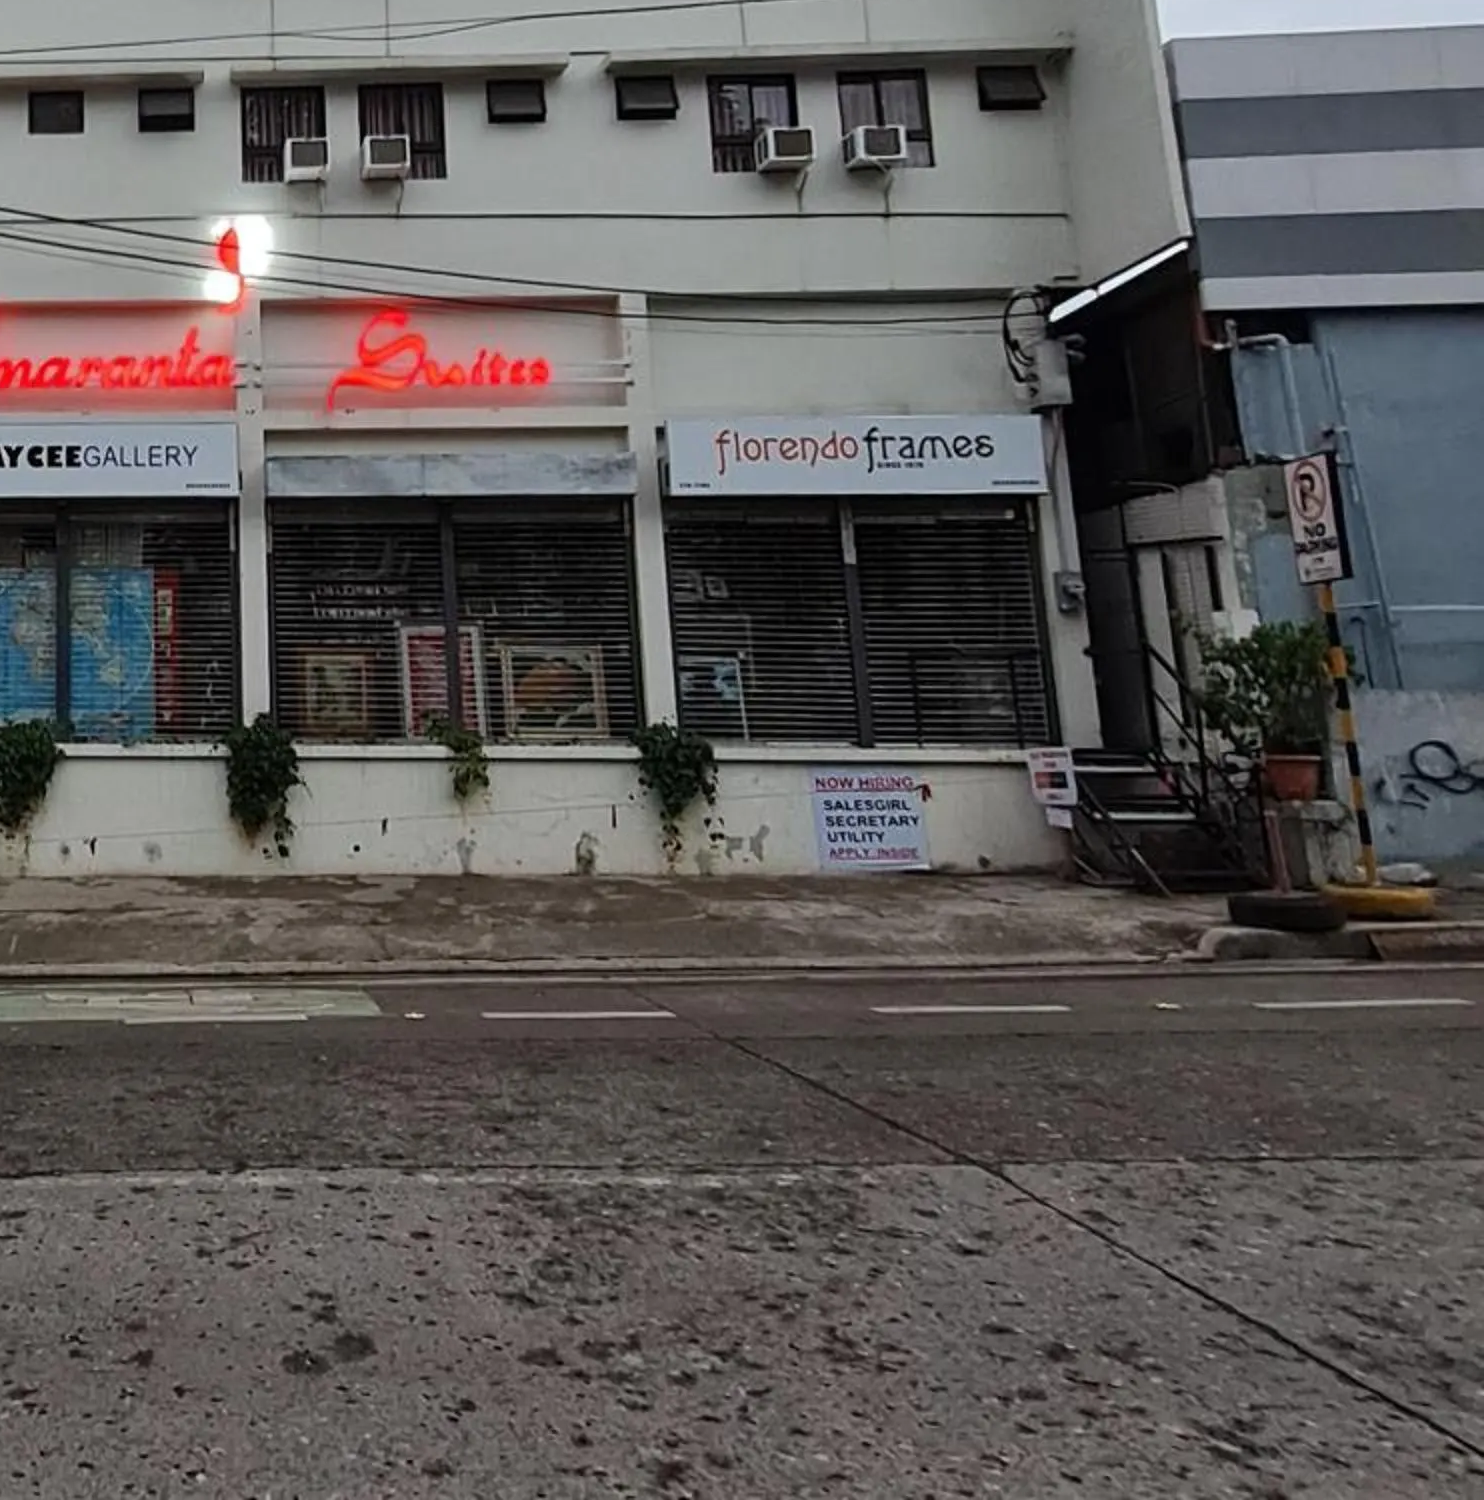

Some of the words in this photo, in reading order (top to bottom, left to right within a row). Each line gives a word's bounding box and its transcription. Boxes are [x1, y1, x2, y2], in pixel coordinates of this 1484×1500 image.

[326, 308, 549, 413] Suites
[715, 429, 859, 476] florendo
[863, 427, 995, 473] frames
[1302, 522, 1326, 538] NO
[815, 777, 854, 789] NOW
[859, 776, 914, 790] HIRING
[823, 800, 912, 811] SALESGIRL
[825, 815, 919, 828] SECRETARY
[827, 831, 885, 843] UTILITY
[830, 847, 870, 859] APPLY
